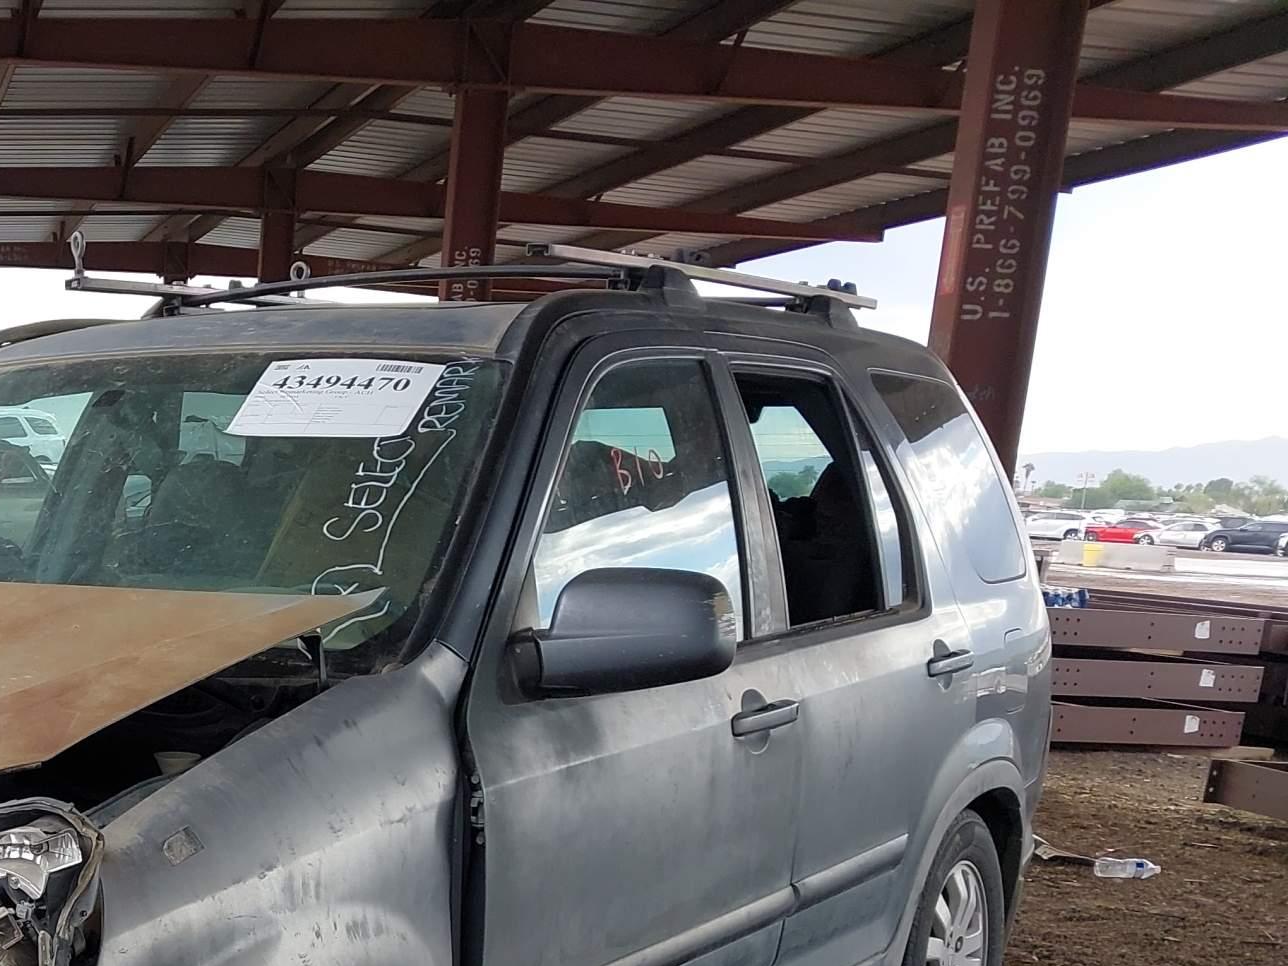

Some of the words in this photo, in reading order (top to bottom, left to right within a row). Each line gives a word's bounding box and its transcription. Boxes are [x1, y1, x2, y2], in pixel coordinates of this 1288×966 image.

[991, 66, 1019, 119] INC.
[972, 137, 1008, 249] PREFAB
[988, 69, 1046, 318] 1-866-799-0969
[960, 267, 991, 320] U.S.
[272, 374, 412, 392] 43494470
